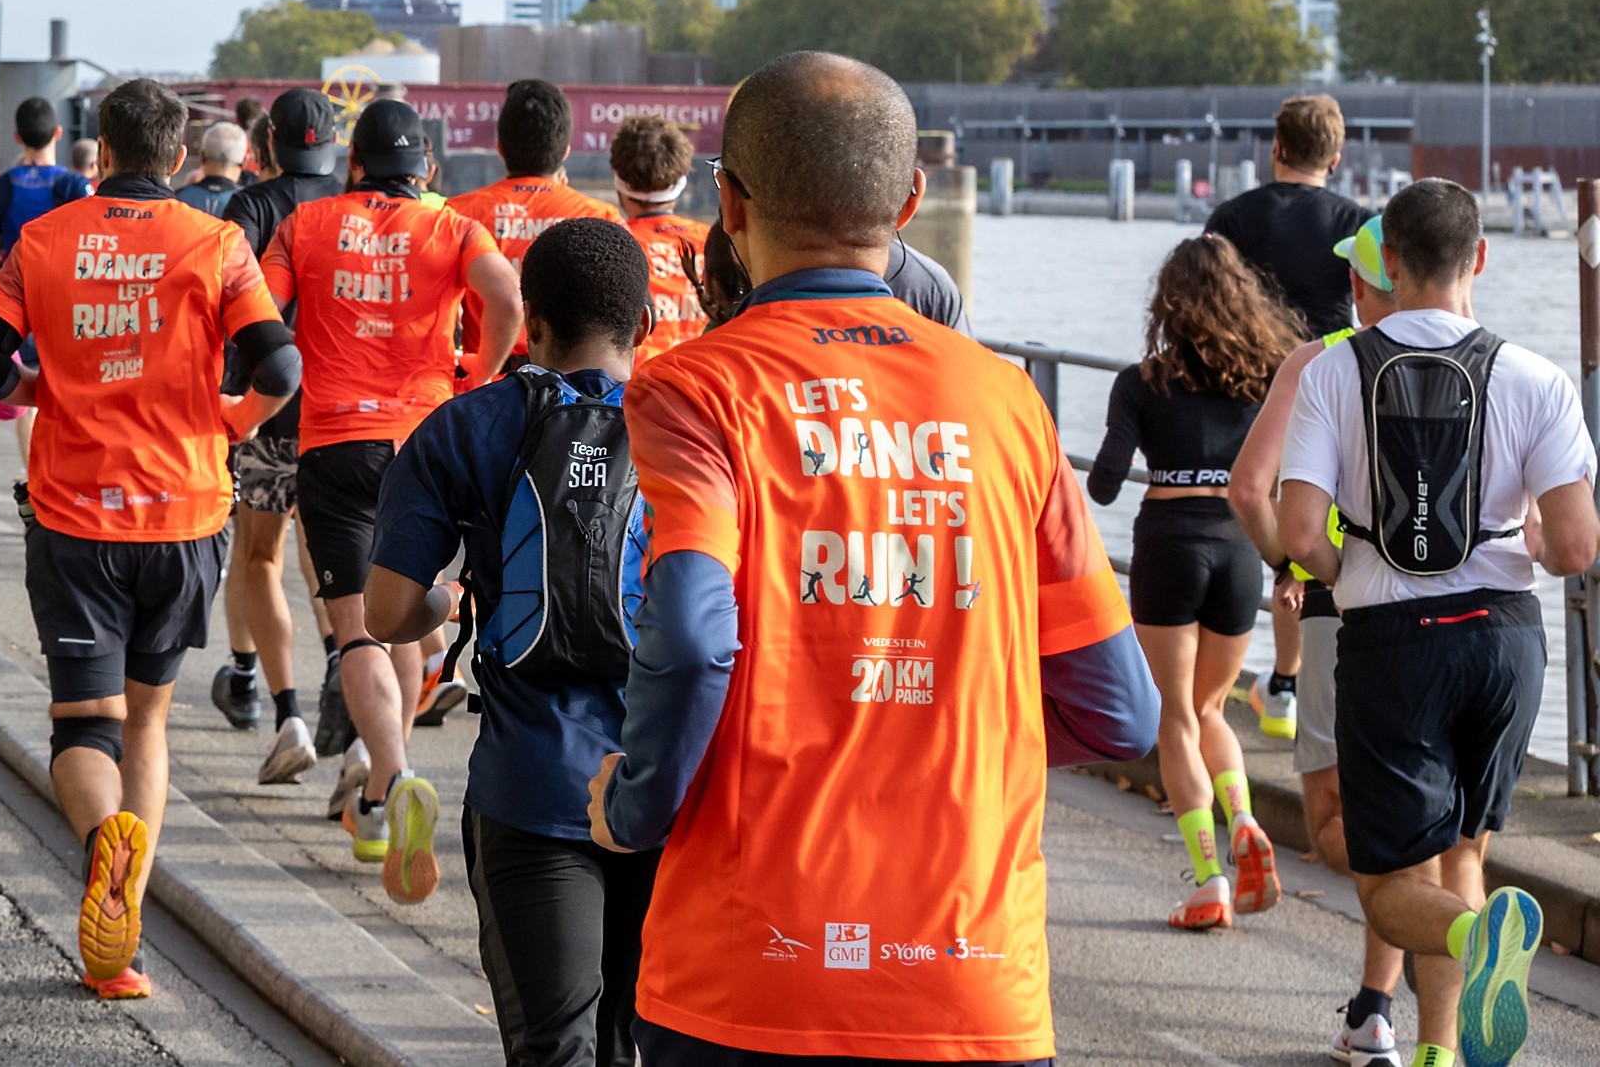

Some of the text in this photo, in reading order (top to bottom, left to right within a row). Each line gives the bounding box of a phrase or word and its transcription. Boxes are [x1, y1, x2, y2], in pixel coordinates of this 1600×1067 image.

[341, 214, 375, 234] LET'S
[78, 234, 119, 251] LET'S
[337, 229, 411, 256] DANCE
[75, 252, 167, 280] DANCE
[373, 257, 406, 272] LET'S
[333, 270, 410, 303] RUN !
[73, 297, 163, 339] RUN !
[355, 320, 376, 338] 20
[811, 324, 914, 346] Joma
[100, 361, 125, 383] 20
[785, 378, 868, 414] LET'S
[571, 441, 607, 457] Team
[795, 417, 973, 483] DANCE
[568, 462, 607, 488] SCA
[1148, 469, 1231, 484] NIKE PR
[887, 489, 966, 527] LET'S
[800, 530, 974, 610] RUN !
[862, 637, 926, 649] VREDESTEIN
[851, 658, 934, 703] 20 KM
[895, 689, 934, 704] PARIS
[829, 946, 866, 963] GMF
[955, 938, 969, 959] 3
